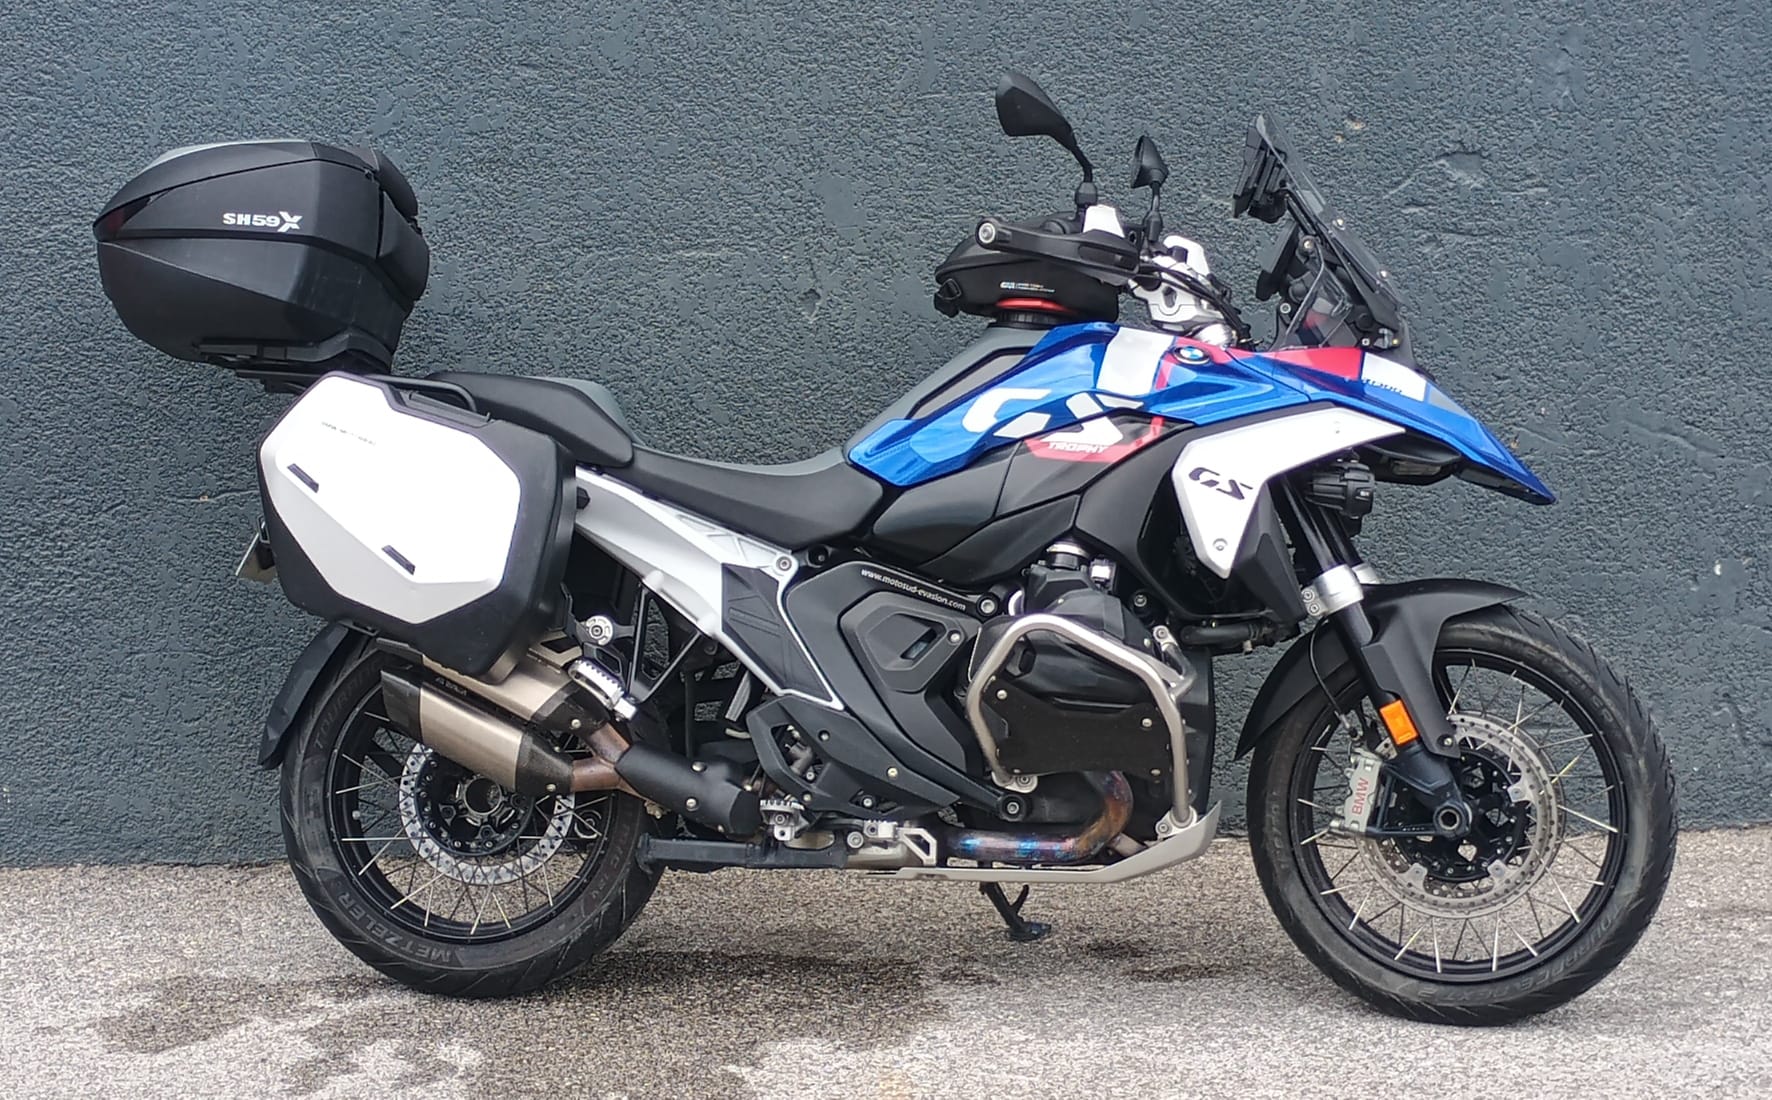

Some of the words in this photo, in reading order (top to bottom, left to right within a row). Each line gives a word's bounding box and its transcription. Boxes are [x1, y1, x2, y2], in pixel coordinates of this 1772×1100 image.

[223, 211, 303, 232] SH59X
[962, 388, 1144, 445] GS
[1048, 441, 1109, 454] TROPHY
[1188, 467, 1254, 500] GS
[861, 569, 967, 611] www.motosud-evasion.com
[1351, 777, 1369, 815] BMW
[336, 888, 452, 963] METZELER
